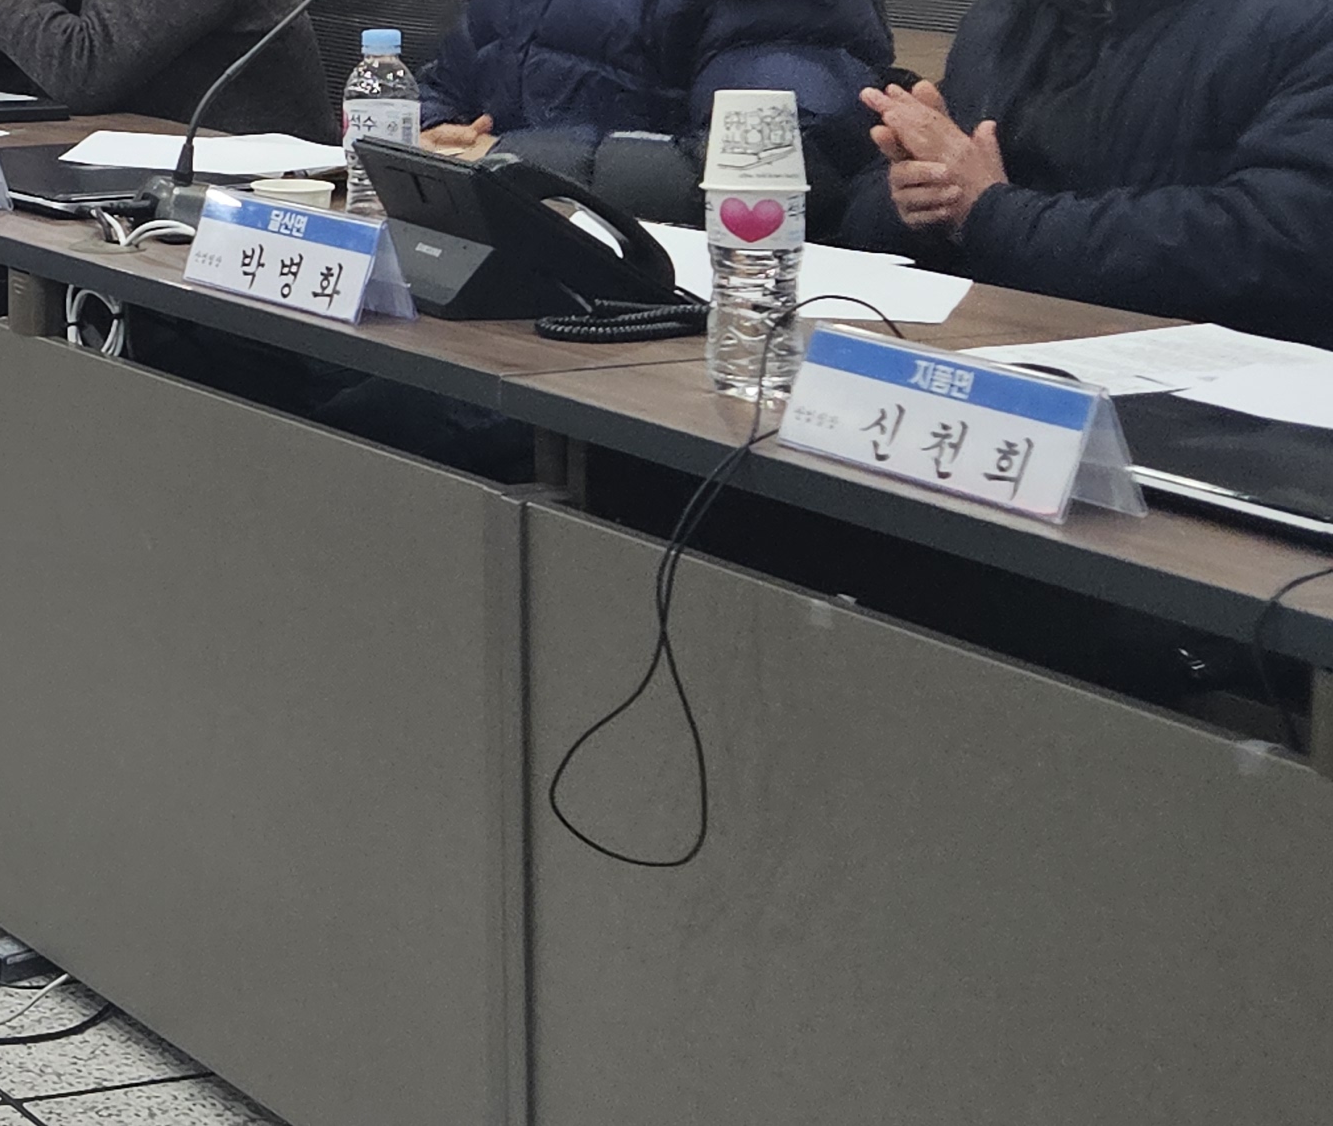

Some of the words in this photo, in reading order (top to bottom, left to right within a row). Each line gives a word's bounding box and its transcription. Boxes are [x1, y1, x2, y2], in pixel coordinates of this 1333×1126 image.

[349, 114, 377, 132] 석수
[241, 243, 343, 311] 박병화
[907, 359, 975, 400] 지품면
[860, 403, 1034, 500] 신천희
